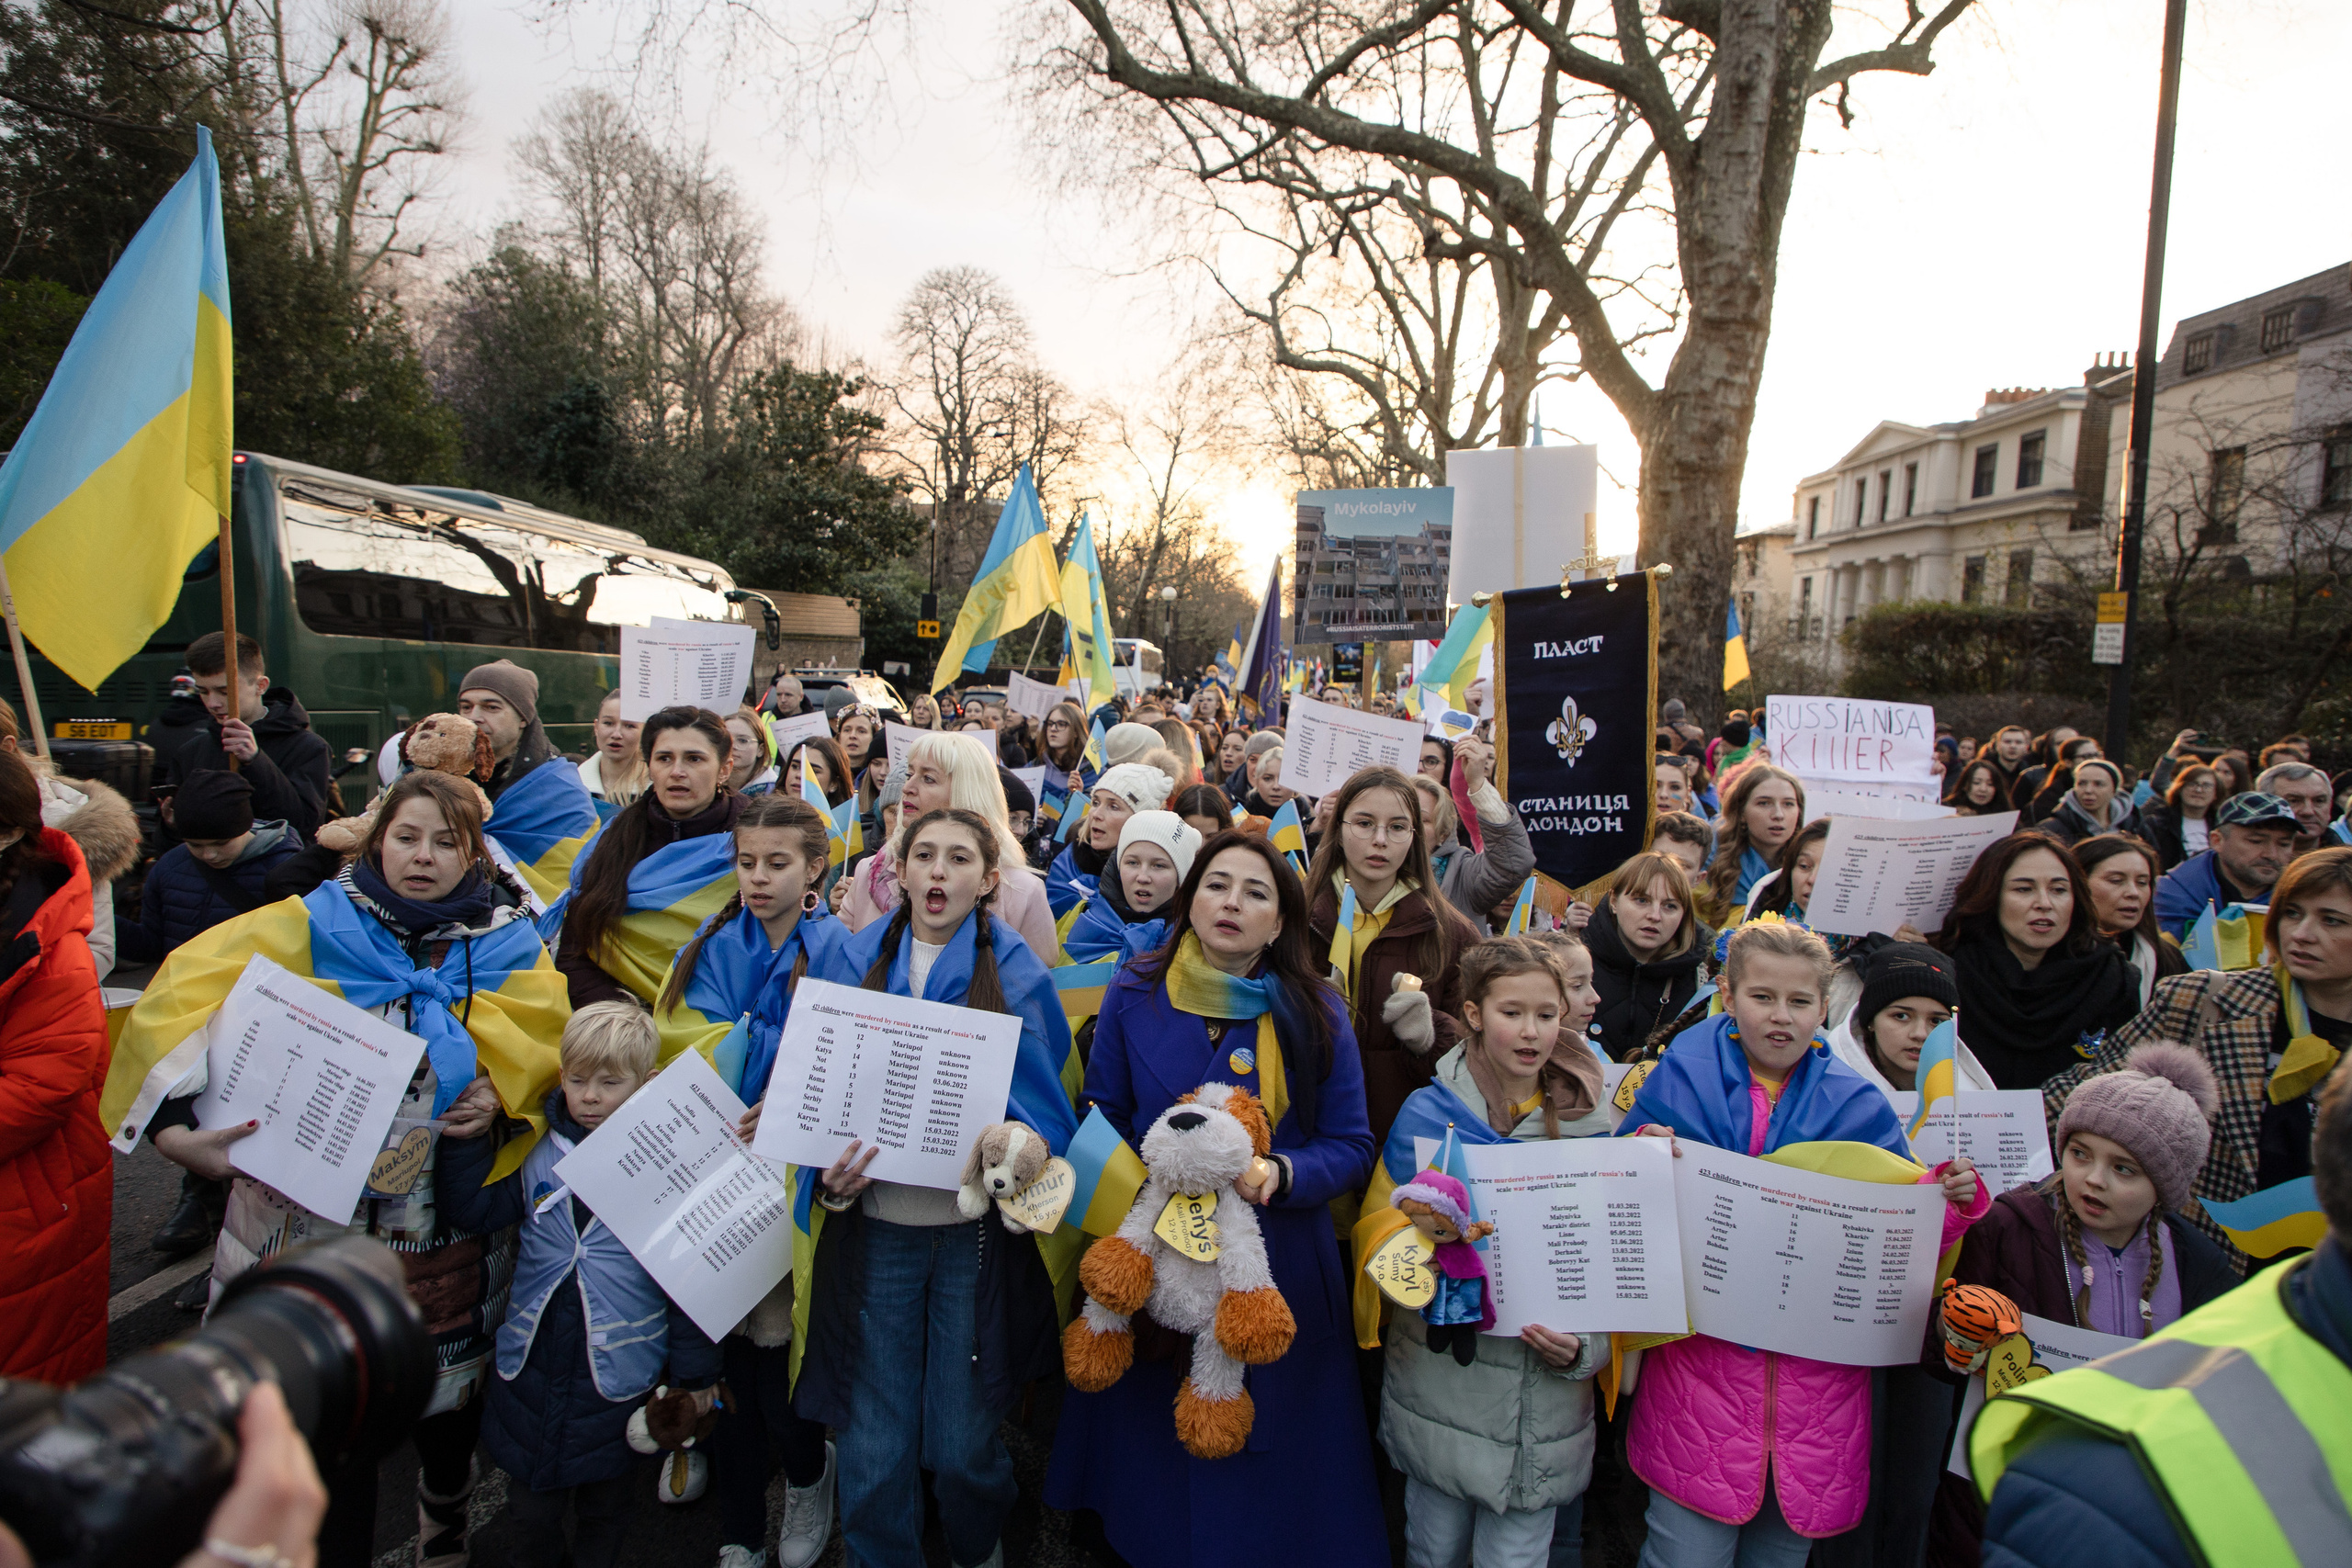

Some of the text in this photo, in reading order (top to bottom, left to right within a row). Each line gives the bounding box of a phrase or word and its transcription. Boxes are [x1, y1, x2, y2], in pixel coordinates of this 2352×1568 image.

[1334, 500, 1417, 517] Mykolayiv
[1533, 635, 1604, 660] ПЛАСТ
[1518, 795, 1630, 814] СТАНИЦЯ
[1527, 816, 1623, 835] ЛОНДОН
[811, 1004, 820, 1012] 423
[820, 1005, 842, 1016] children
[855, 1013, 884, 1022] murdered
[306, 1023, 324, 1035] against
[881, 1027, 903, 1035] against
[904, 1030, 929, 1040] Ukraine
[818, 1035, 834, 1044] Olena
[890, 1050, 922, 1062] Mariupol
[938, 1060, 969, 1070] unknown
[821, 1026, 834, 1034] Glib
[892, 1040, 923, 1052] Mariupol
[940, 1050, 971, 1060] unknown
[815, 1044, 832, 1055] Katya
[888, 1059, 920, 1071] Mariupol
[936, 1070, 967, 1080] unknown
[816, 1055, 827, 1064] Not
[887, 1069, 918, 1081] Mariupol
[933, 1077, 967, 1089] 03.06.2022
[1638, 1064, 1647, 1084] Arte
[811, 1065, 826, 1074] Sofia
[885, 1078, 916, 1090] Mariupol
[933, 1089, 964, 1100] unknown
[1622, 1086, 1629, 1095] 15
[799, 1122, 813, 1131] Max
[875, 1136, 905, 1149] Mariupol
[921, 1145, 956, 1156] 23.03.2022
[370, 1136, 428, 1183] Maksym
[631, 1148, 647, 1166] Nastya
[387, 1157, 422, 1186] Mariupol
[394, 1182, 403, 1192] 17
[1527, 1183, 1549, 1191] against
[1698, 1168, 1712, 1179] 423
[1711, 1172, 1742, 1188] children
[1741, 1181, 1759, 1190] were
[1760, 1186, 1796, 1199] murdered
[1797, 1193, 1807, 1202] by
[1808, 1197, 1830, 1206] russia
[1026, 1195, 1059, 1213] Kherson
[1714, 1194, 1734, 1204] Artem
[1842, 1224, 1874, 1233] Rybakivka
[1034, 1214, 1044, 1223] 16
[1168, 1218, 1177, 1227] 12
[1549, 1213, 1582, 1222] Malynivka
[1704, 1216, 1737, 1229] Artemchyk
[1176, 1202, 1192, 1253] Mali Prohody
[1844, 1232, 1870, 1240] Kharkiv
[1390, 1252, 1401, 1282] Sumy
[1401, 1245, 1419, 1292] Kyryl
[2037, 1344, 2090, 1362] children were
[2002, 1351, 2028, 1385] Polin
[1992, 1380, 2001, 1390] 12
